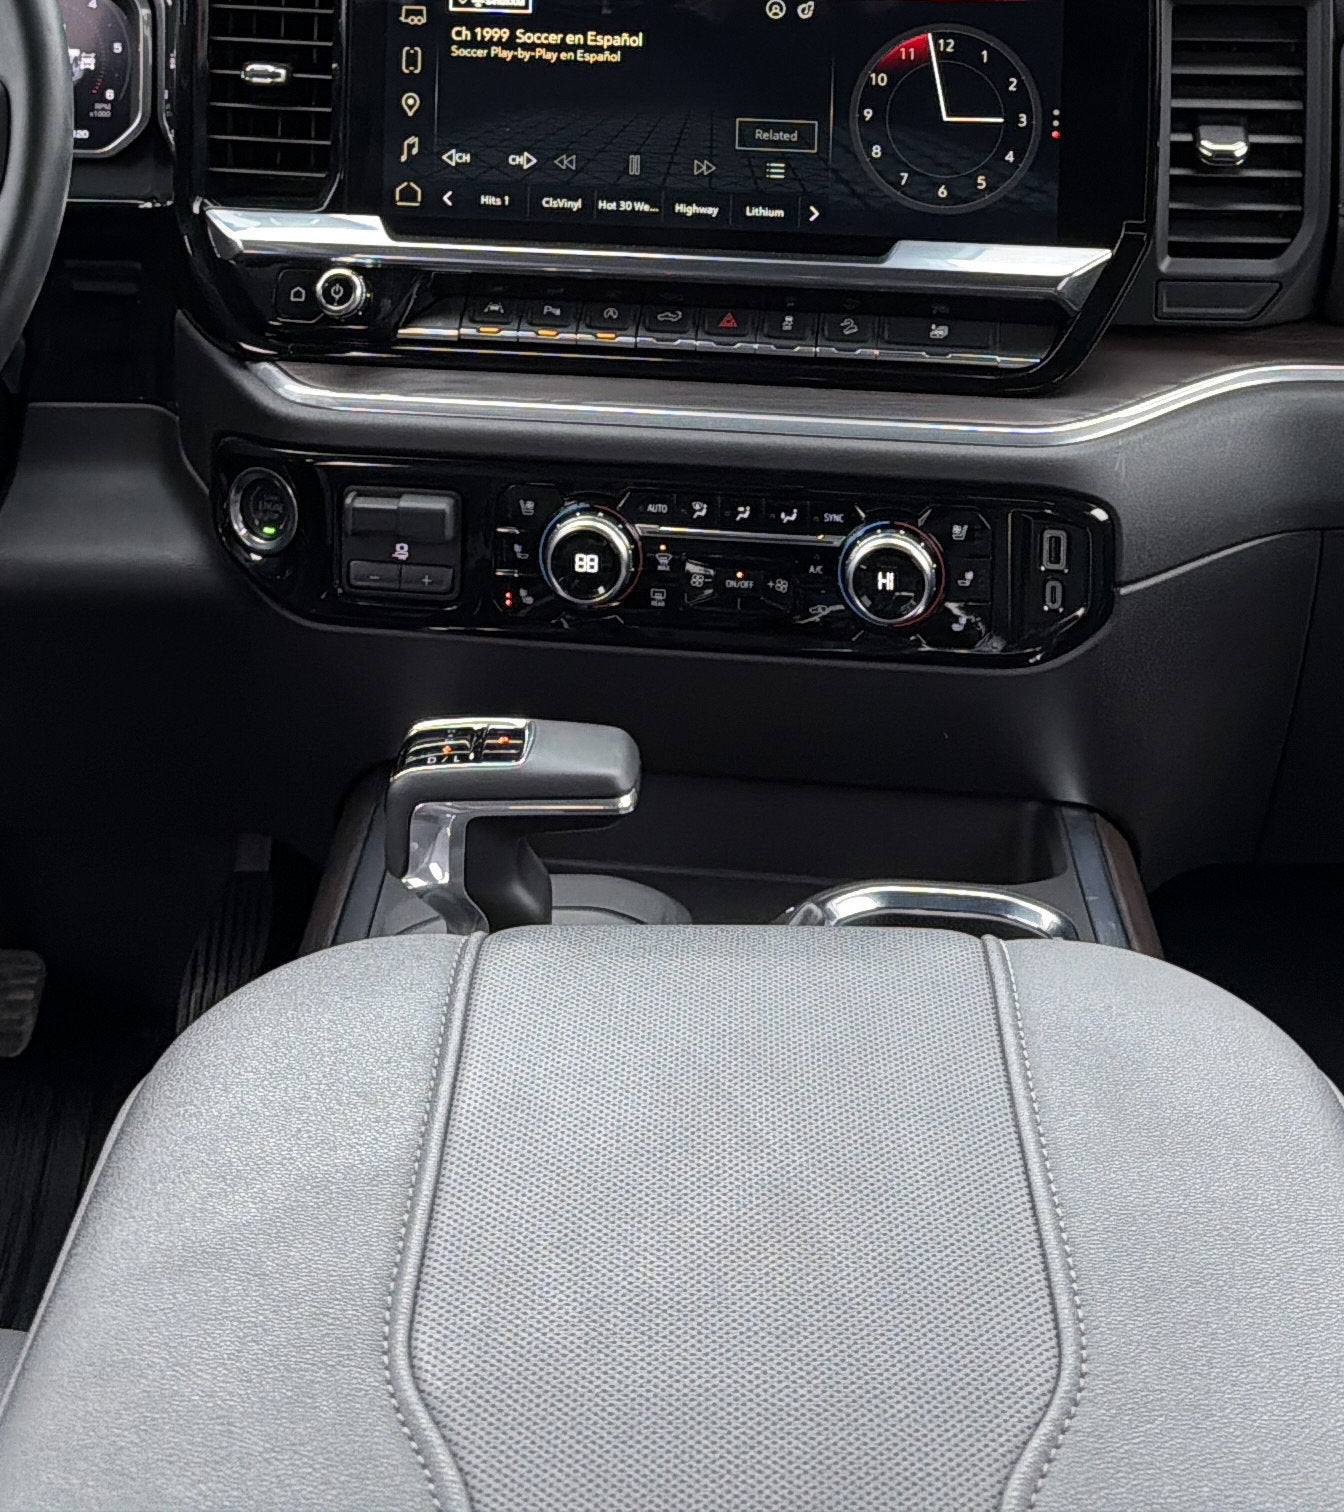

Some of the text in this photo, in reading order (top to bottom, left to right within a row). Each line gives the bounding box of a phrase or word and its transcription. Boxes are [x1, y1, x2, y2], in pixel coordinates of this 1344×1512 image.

[451, 26, 644, 49] Ch 1999 Soccer en Español
[113, 42, 123, 54] 5
[938, 39, 955, 52] 12
[450, 45, 621, 64] Soccer Play-by-Play en Español
[899, 47, 915, 60] 11
[981, 50, 988, 63] 1
[870, 73, 888, 86] 10
[1008, 78, 1018, 91] 2
[863, 108, 873, 121] 9
[1018, 114, 1027, 127] 3
[755, 129, 798, 142] Related
[456, 152, 471, 163] CH
[871, 145, 882, 158] 8
[1004, 151, 1014, 163] 4
[508, 154, 524, 165] CH
[900, 173, 909, 185] 7
[977, 176, 987, 190] 5
[937, 185, 948, 198] 6
[480, 195, 497, 206] Hits
[541, 197, 583, 211] ClsVinyl
[598, 200, 617, 211] Hot
[619, 201, 633, 211] 30
[675, 203, 719, 218] Highway
[745, 206, 785, 218] Lithium
[647, 503, 668, 514] AUTO
[823, 512, 844, 523] SYNC
[808, 565, 824, 575] A/C
[725, 579, 754, 589] ON/OFF
